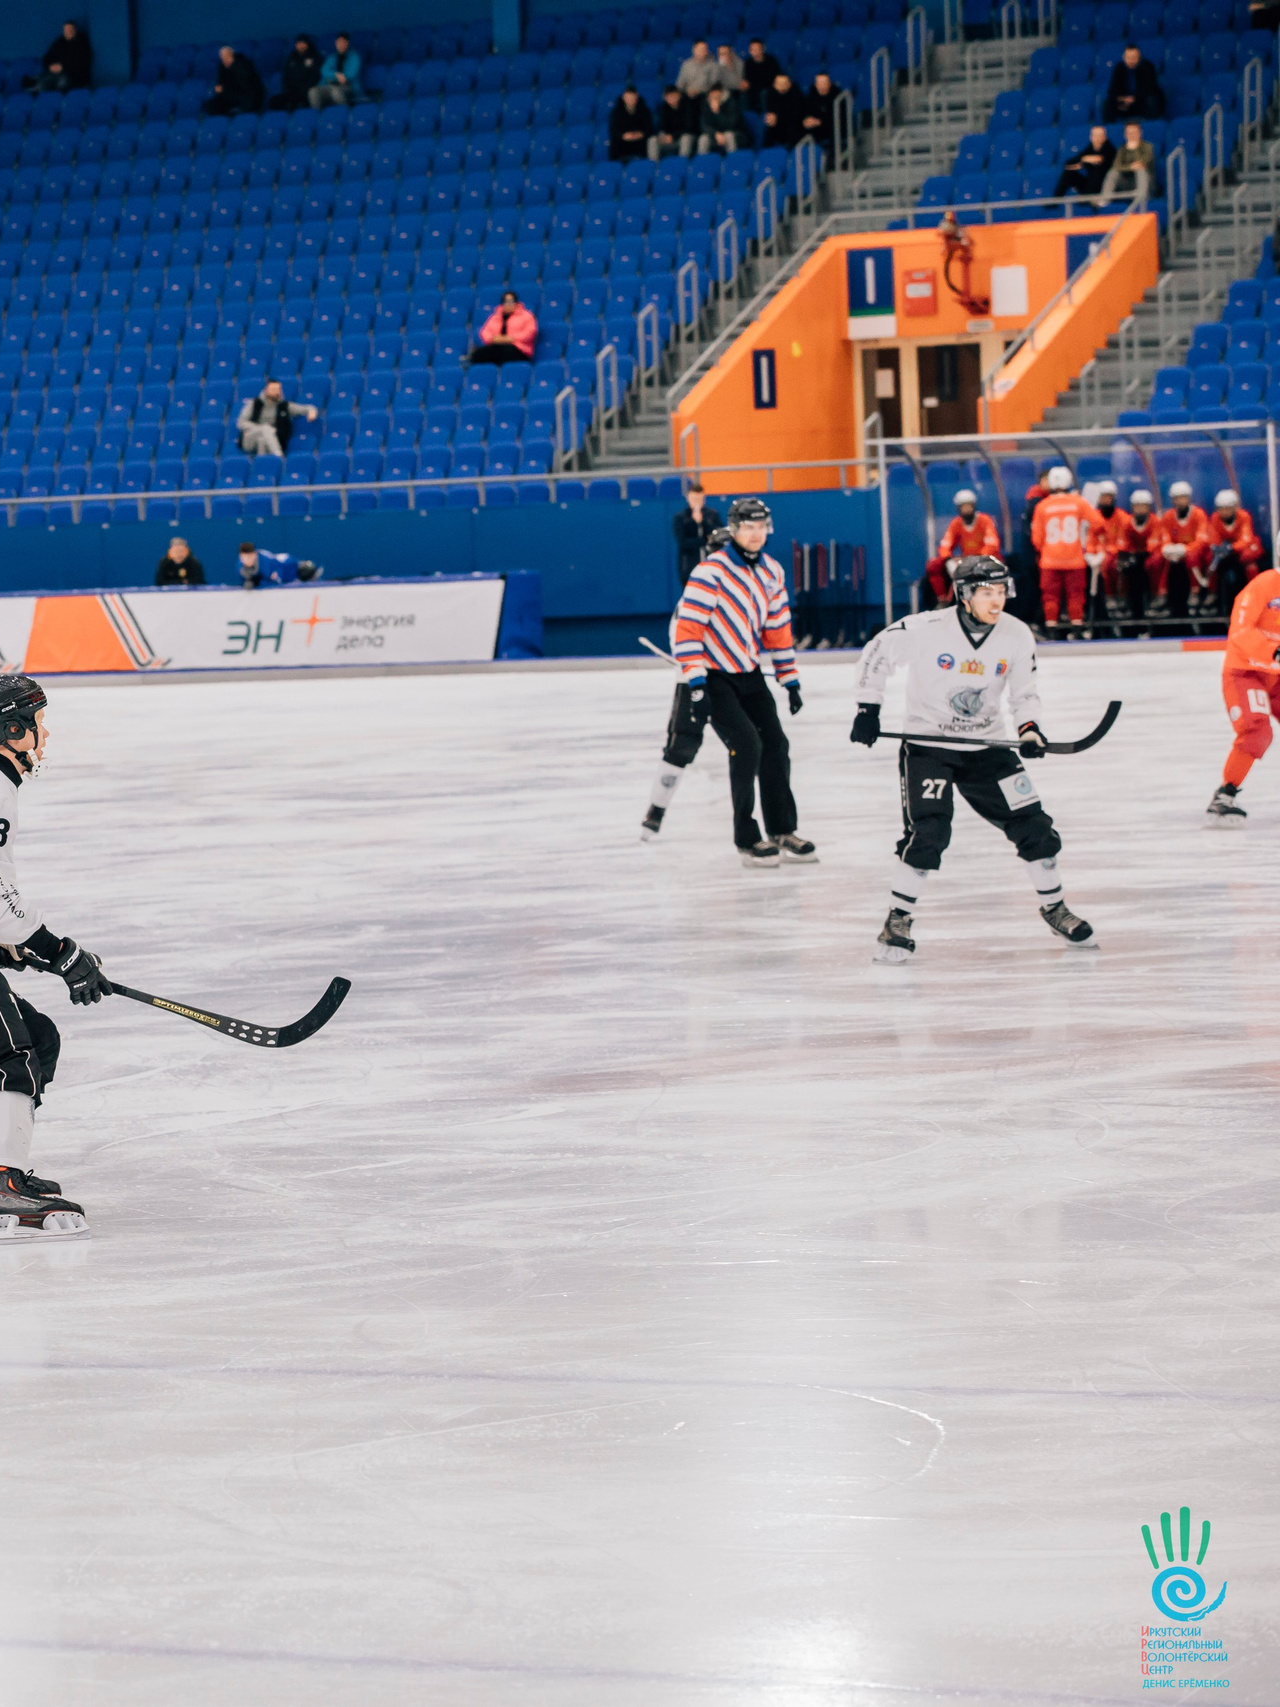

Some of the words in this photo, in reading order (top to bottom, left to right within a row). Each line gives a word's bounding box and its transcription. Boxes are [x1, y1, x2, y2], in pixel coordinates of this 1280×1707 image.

[339, 613, 415, 633] энергия
[335, 634, 385, 651] дела
[922, 778, 947, 799] 27
